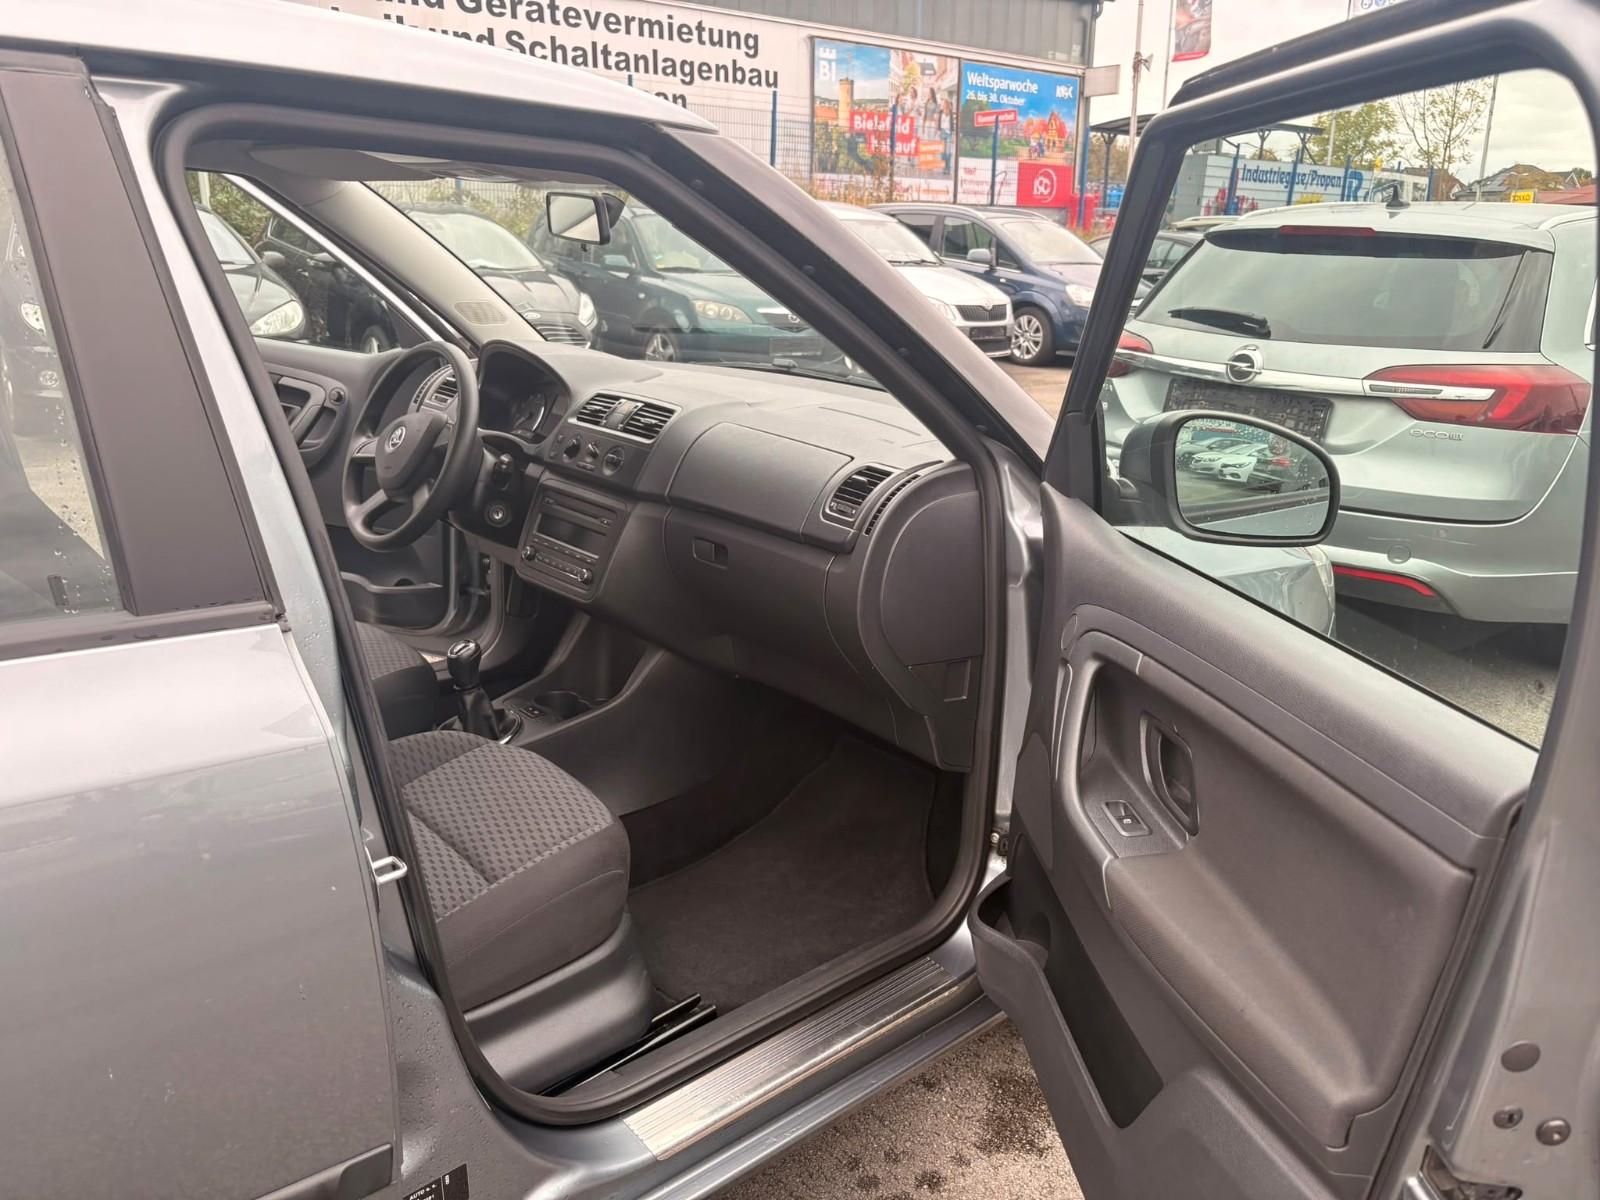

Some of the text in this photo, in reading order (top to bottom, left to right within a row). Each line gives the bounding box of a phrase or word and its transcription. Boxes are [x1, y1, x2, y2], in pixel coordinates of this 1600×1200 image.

[505, 29, 779, 89] Schaltanlagenbau
[966, 71, 1039, 94] Weltsparwoche
[853, 114, 911, 135] Bielefld
[1242, 163, 1342, 191] Industriegse/Propan
